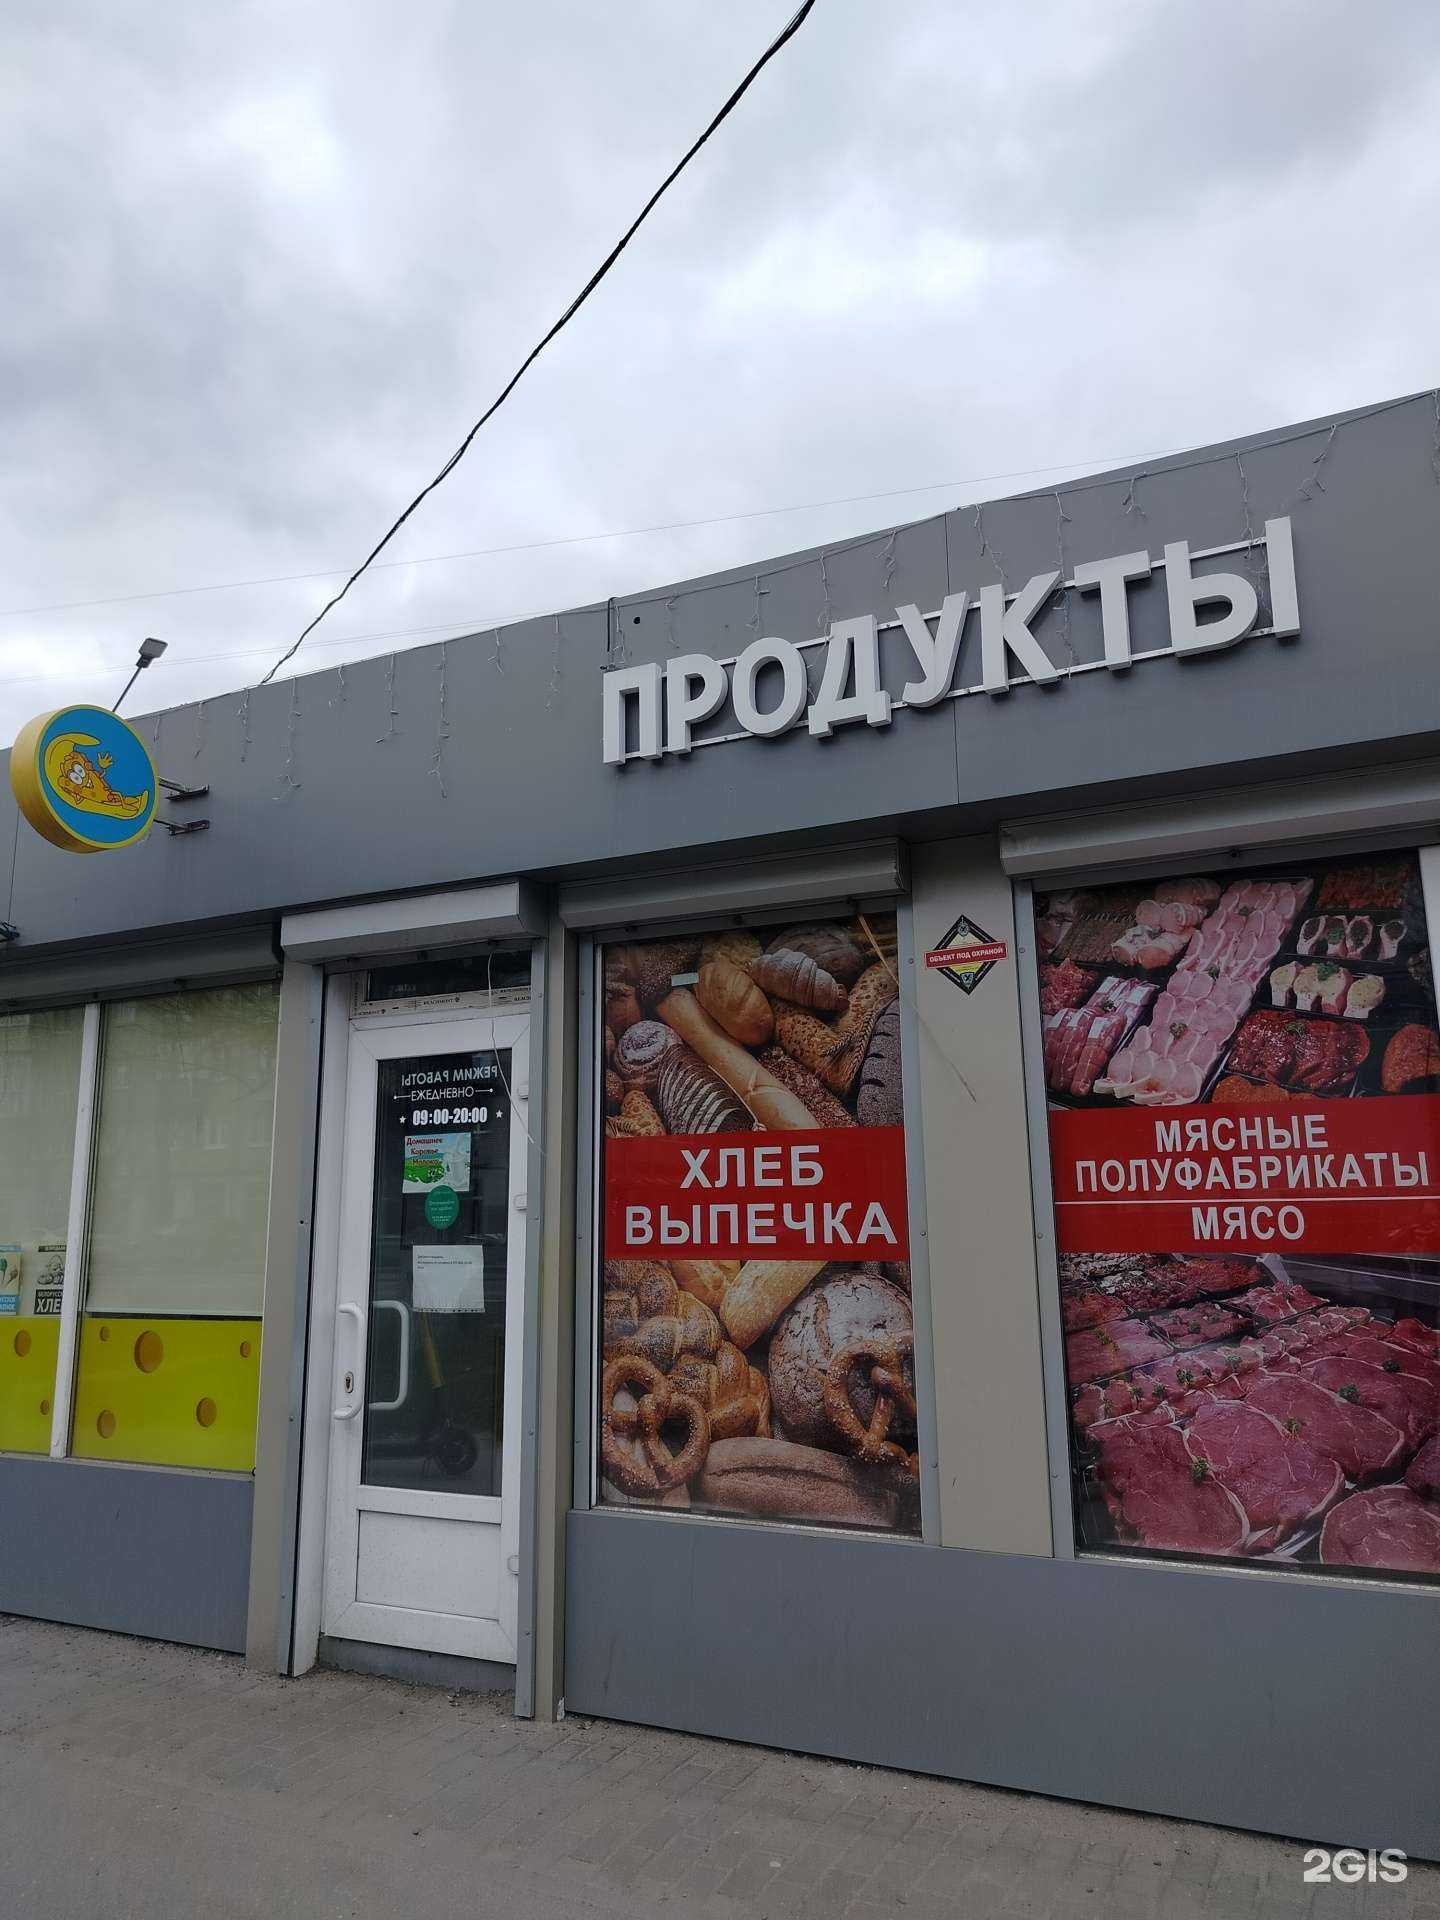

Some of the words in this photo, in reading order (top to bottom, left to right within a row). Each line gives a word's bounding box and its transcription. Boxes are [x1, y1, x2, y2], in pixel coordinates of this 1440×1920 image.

[603, 516, 1300, 765] ПРОДУКТЫ
[929, 953, 955, 962] ОБЪЕКТ
[956, 952, 970, 960] ПОД
[971, 947, 1003, 957] ОХРАНОЙ
[411, 1086, 474, 1101] ЕЖЕДНЕВНО
[412, 1107, 487, 1125] 09:00-20:00
[1154, 1114, 1328, 1153] МЯСНЫЕ
[679, 1145, 824, 1188] ХЛЕБ
[1075, 1151, 1429, 1193] ПОЛУФАБРИКАТЫ
[625, 1202, 898, 1245] ВЫПЕЧКА
[1191, 1205, 1305, 1240] МЯСО
[36, 1298, 61, 1313] ХЛЕ
